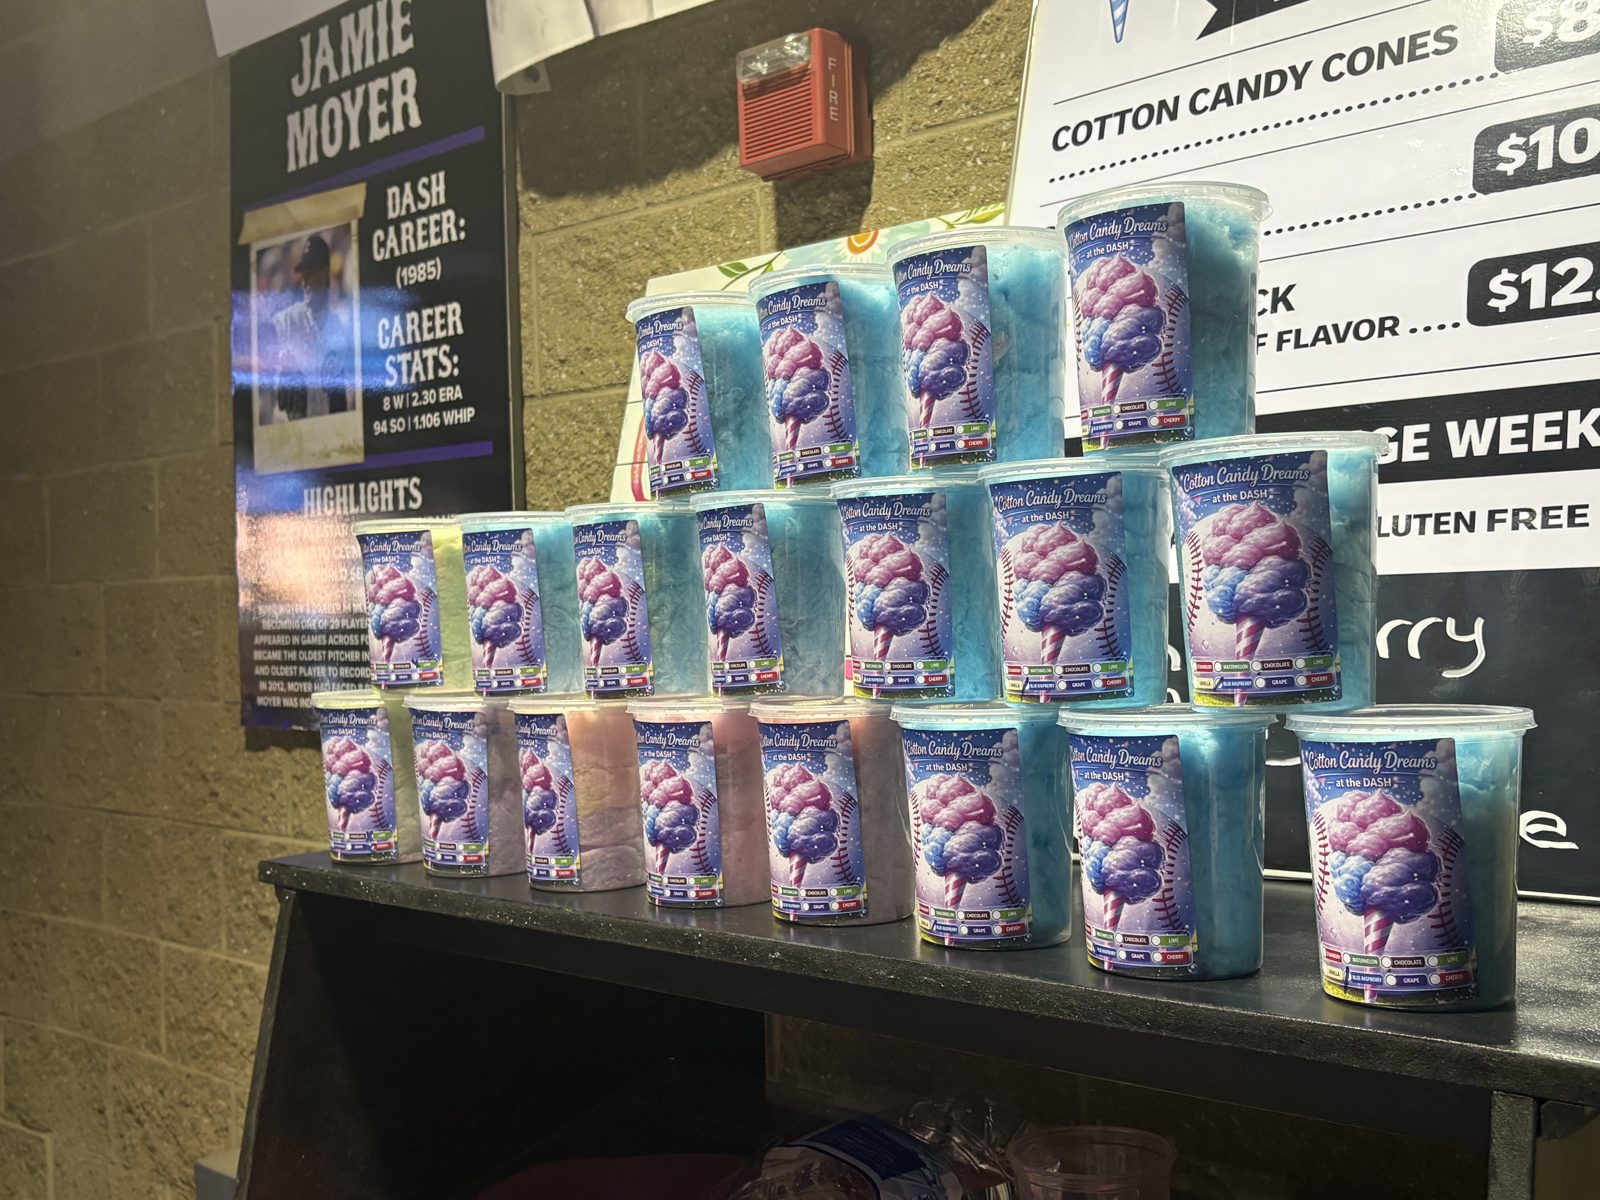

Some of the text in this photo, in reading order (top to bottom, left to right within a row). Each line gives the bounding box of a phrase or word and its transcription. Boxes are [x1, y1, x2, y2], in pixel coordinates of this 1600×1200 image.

[291, 0, 415, 98] JAMIE
[828, 57, 840, 121] FIRE
[1052, 24, 1458, 152] COTTON CANDY CONES
[286, 66, 422, 174] MOYER
[386, 170, 447, 220] DASH
[372, 208, 466, 262] CAREER:
[1090, 216, 1167, 240] Candy Dreams
[1093, 247, 1105, 256] the
[1106, 241, 1129, 254] DASH
[396, 256, 442, 290] (1985)
[908, 262, 933, 280] Candy
[934, 259, 972, 276] Dreams
[768, 299, 792, 316] Candy
[792, 294, 826, 310] Dreams
[377, 301, 464, 350] CAREER
[654, 319, 683, 335] Dreams
[1276, 315, 1400, 352] FLAVOR
[384, 344, 459, 387] STATS:
[383, 384, 463, 411] 8 W 2.30 ERA
[1121, 403, 1145, 411] CHOCOLATE
[373, 420, 388, 436] 94
[443, 407, 476, 426] WHIP
[1182, 463, 1309, 493] Cotton Candy Dreams
[303, 476, 423, 517] HIGHLIGHTS
[998, 487, 1106, 512] Cotton Candy Dreams
[1212, 490, 1268, 503] at the DASH
[862, 502, 892, 521] Candy
[893, 501, 931, 517] Dreams
[1022, 511, 1069, 523] at the DASH
[1378, 503, 1590, 538] LUTEN FREE
[703, 514, 753, 532] Candy Dreams
[866, 523, 877, 531] the
[878, 522, 898, 531] DASH
[370, 540, 391, 555] Candy
[392, 539, 421, 552] Dreams
[471, 539, 523, 555] Candy Dreams
[578, 529, 627, 546] Candy Dreams
[254, 634, 291, 646] APPEARED
[292, 634, 300, 645] IN
[302, 634, 327, 645] GAMES
[328, 634, 360, 645] ACROSS
[1375, 616, 1486, 678] rry
[254, 649, 282, 661] BECAME
[283, 650, 298, 661] THE
[299, 650, 327, 661] OLDEST
[328, 650, 361, 661] PITCHER
[255, 665, 270, 677] AND
[271, 665, 298, 677] OLDEST
[300, 666, 327, 677] PLAYER
[328, 666, 339, 677] TO
[340, 666, 371, 678] RECORD
[1263, 661, 1290, 669] CHOCOLATE
[260, 680, 267, 692] IN
[287, 681, 313, 693] MOYER
[329, 711, 377, 727] Candy Dreams
[423, 715, 475, 731] Candy Dreams
[532, 722, 557, 737] Dreams
[645, 730, 700, 748] Candy Dreams
[774, 732, 837, 751] Candy Dreams
[928, 742, 960, 760] Candy
[962, 741, 1002, 758] Dreams
[926, 762, 968, 772] at the DASH
[1086, 747, 1162, 769] Candy Dreams
[1309, 749, 1436, 773] Cotton Candy Dreams
[1091, 771, 1101, 780] the
[1103, 771, 1125, 780] DASH
[1345, 778, 1361, 787] the
[1363, 778, 1391, 788] DASH
